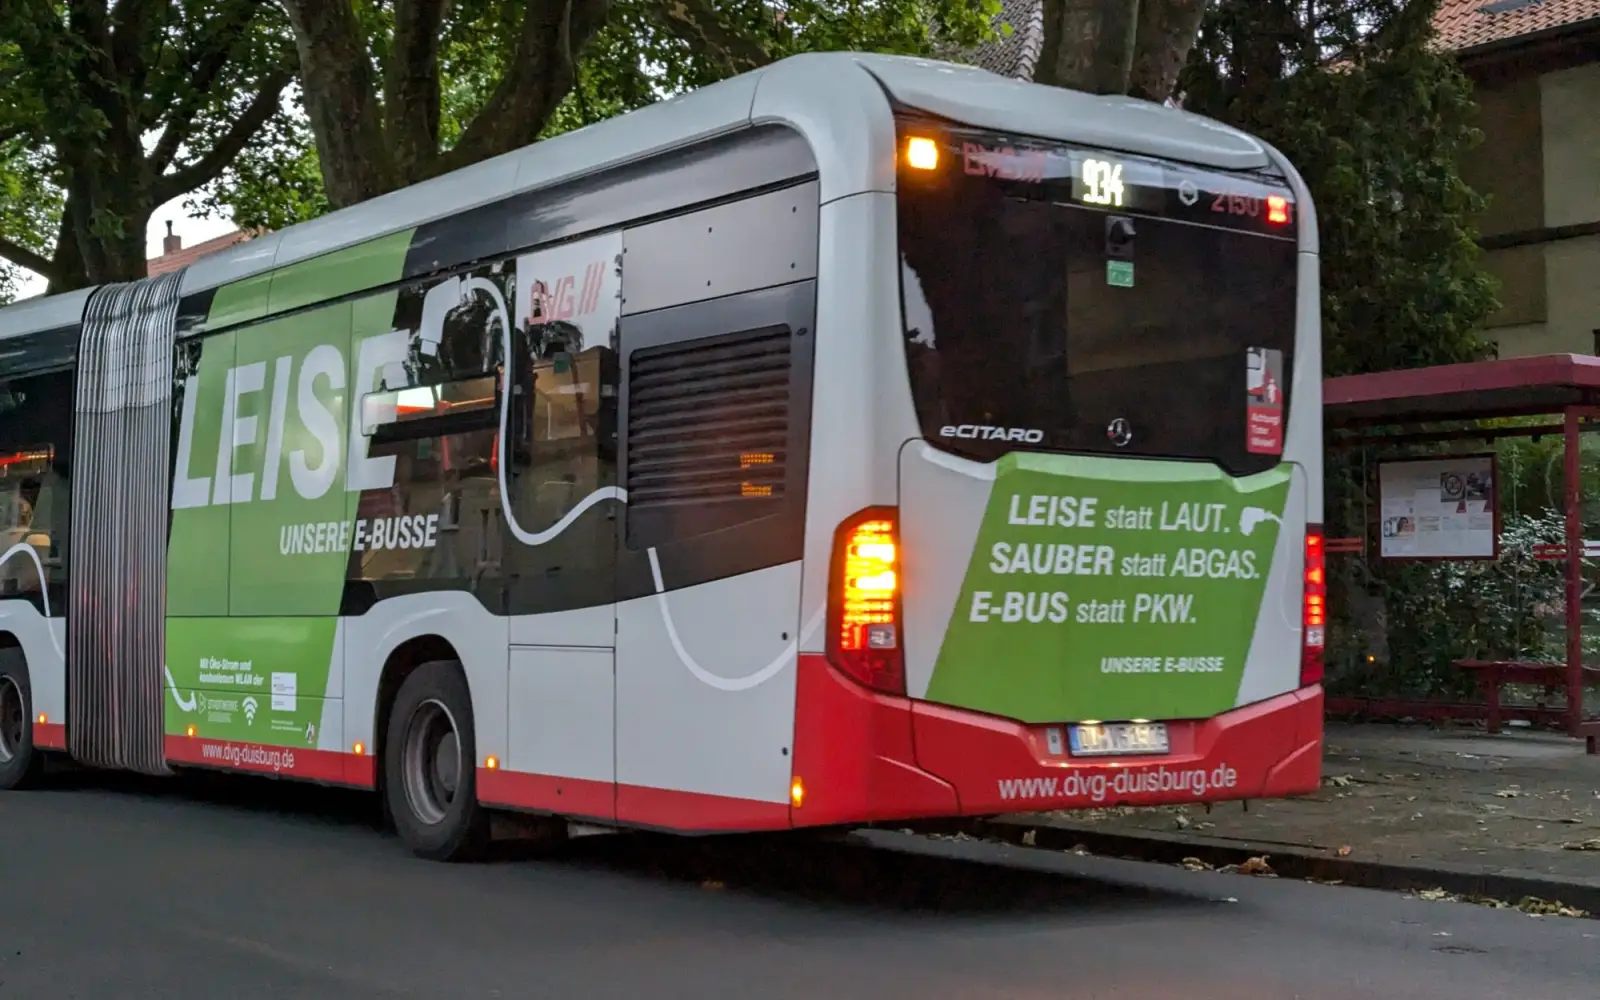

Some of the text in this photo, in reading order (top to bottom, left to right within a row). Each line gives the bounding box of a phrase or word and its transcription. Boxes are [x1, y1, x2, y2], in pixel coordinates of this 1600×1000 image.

[1082, 159, 1125, 207] 934
[171, 328, 410, 510] LEISE
[939, 424, 1044, 444] eCITARO
[1008, 494, 1231, 533] LEISE statt LAUT.
[279, 514, 439, 555] UNSERE E-BUSSE
[989, 542, 1261, 579] SAUBER statt ABGAS.
[969, 591, 1198, 624] E-BUS statt PKW.
[1101, 657, 1225, 673] UNSERE E-BUSSE
[203, 743, 294, 770] www.dvg-duisburg.de
[997, 764, 1237, 800] www.dvg-duisburg.de
